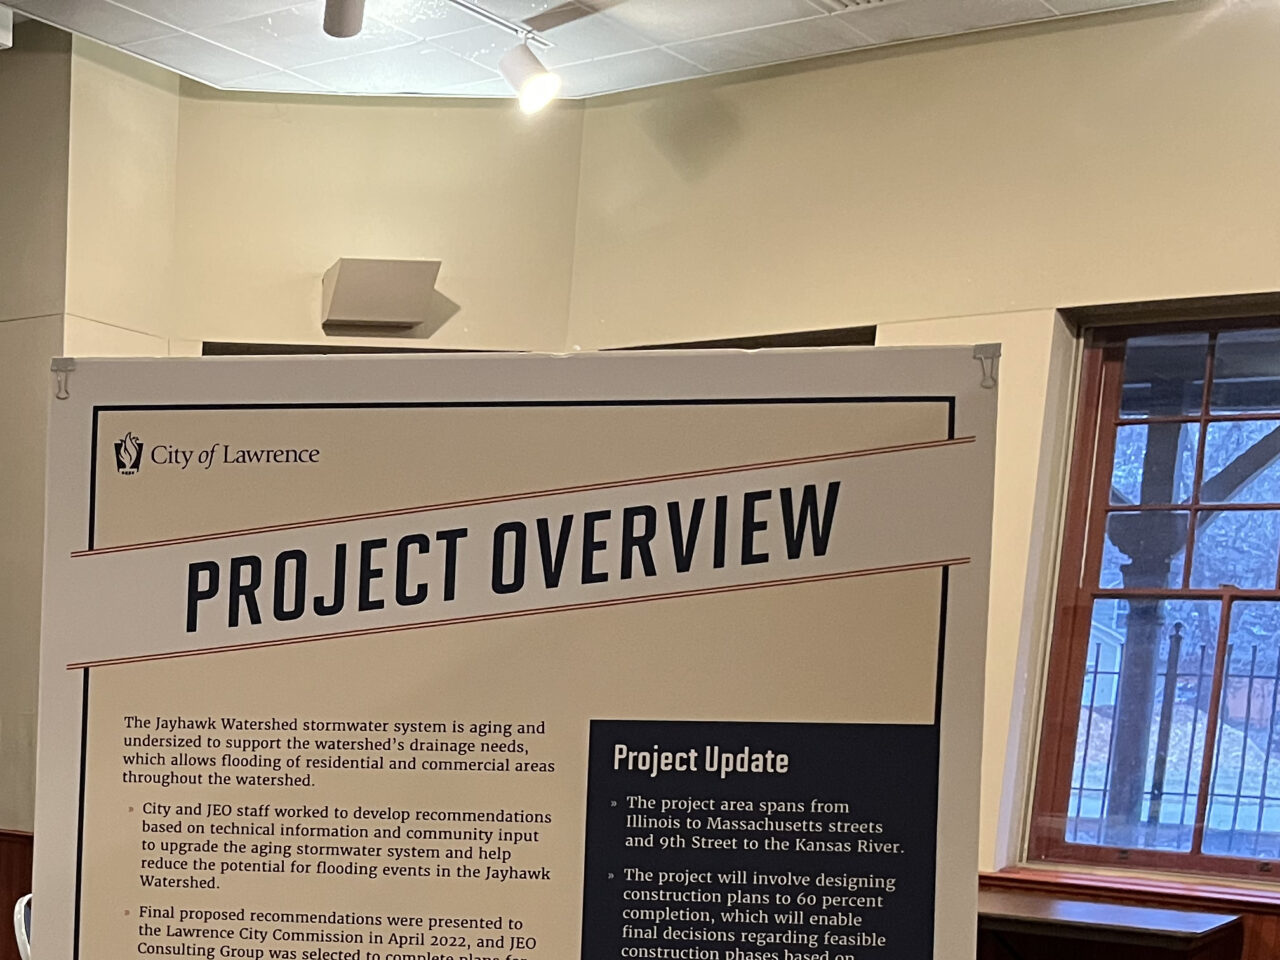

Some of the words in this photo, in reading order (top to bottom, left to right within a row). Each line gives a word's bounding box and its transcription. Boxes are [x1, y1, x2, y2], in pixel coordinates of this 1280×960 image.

[150, 445, 193, 470] City
[198, 443, 220, 469] of
[223, 444, 320, 463] Lawrence
[186, 527, 468, 633] PROJECT
[491, 480, 841, 595] OVERVIEW
[123, 715, 151, 729] The
[155, 716, 216, 732] Jayhawk
[220, 717, 297, 731] Watershed
[302, 719, 389, 732] stormwater
[393, 721, 446, 736] system
[452, 720, 464, 733] is
[469, 720, 512, 738] aging
[517, 720, 545, 734] and
[123, 733, 201, 748] undersized
[207, 737, 221, 748] to
[225, 738, 281, 752] support
[287, 736, 310, 749] the
[314, 737, 404, 751] watershed’s
[409, 738, 475, 755] drainage
[480, 739, 528, 755] needs,
[122, 751, 165, 765] which
[170, 752, 216, 766] allows
[221, 753, 281, 771] flooding
[286, 754, 301, 768] of
[305, 755, 383, 769] residential
[388, 756, 416, 769] and
[421, 758, 509, 771] commercial
[514, 762, 555, 772] areas
[613, 744, 698, 778] Project
[705, 745, 789, 779] Update
[122, 770, 202, 787] throughout
[208, 771, 231, 785] the
[235, 773, 315, 787] watershed.
[626, 795, 656, 809] The
[661, 796, 715, 813] project
[720, 800, 753, 811] area
[759, 801, 804, 815] spans
[810, 798, 849, 813] from
[626, 814, 680, 828] Illinois
[686, 817, 701, 829] to
[706, 816, 822, 832] Massachusetts
[828, 821, 883, 833] streets
[625, 833, 653, 847] and
[659, 834, 685, 849] 9th
[691, 835, 737, 849] Street
[743, 838, 758, 850] to
[764, 836, 790, 850] the
[795, 838, 851, 852] Kansas
[857, 839, 904, 853] River.
